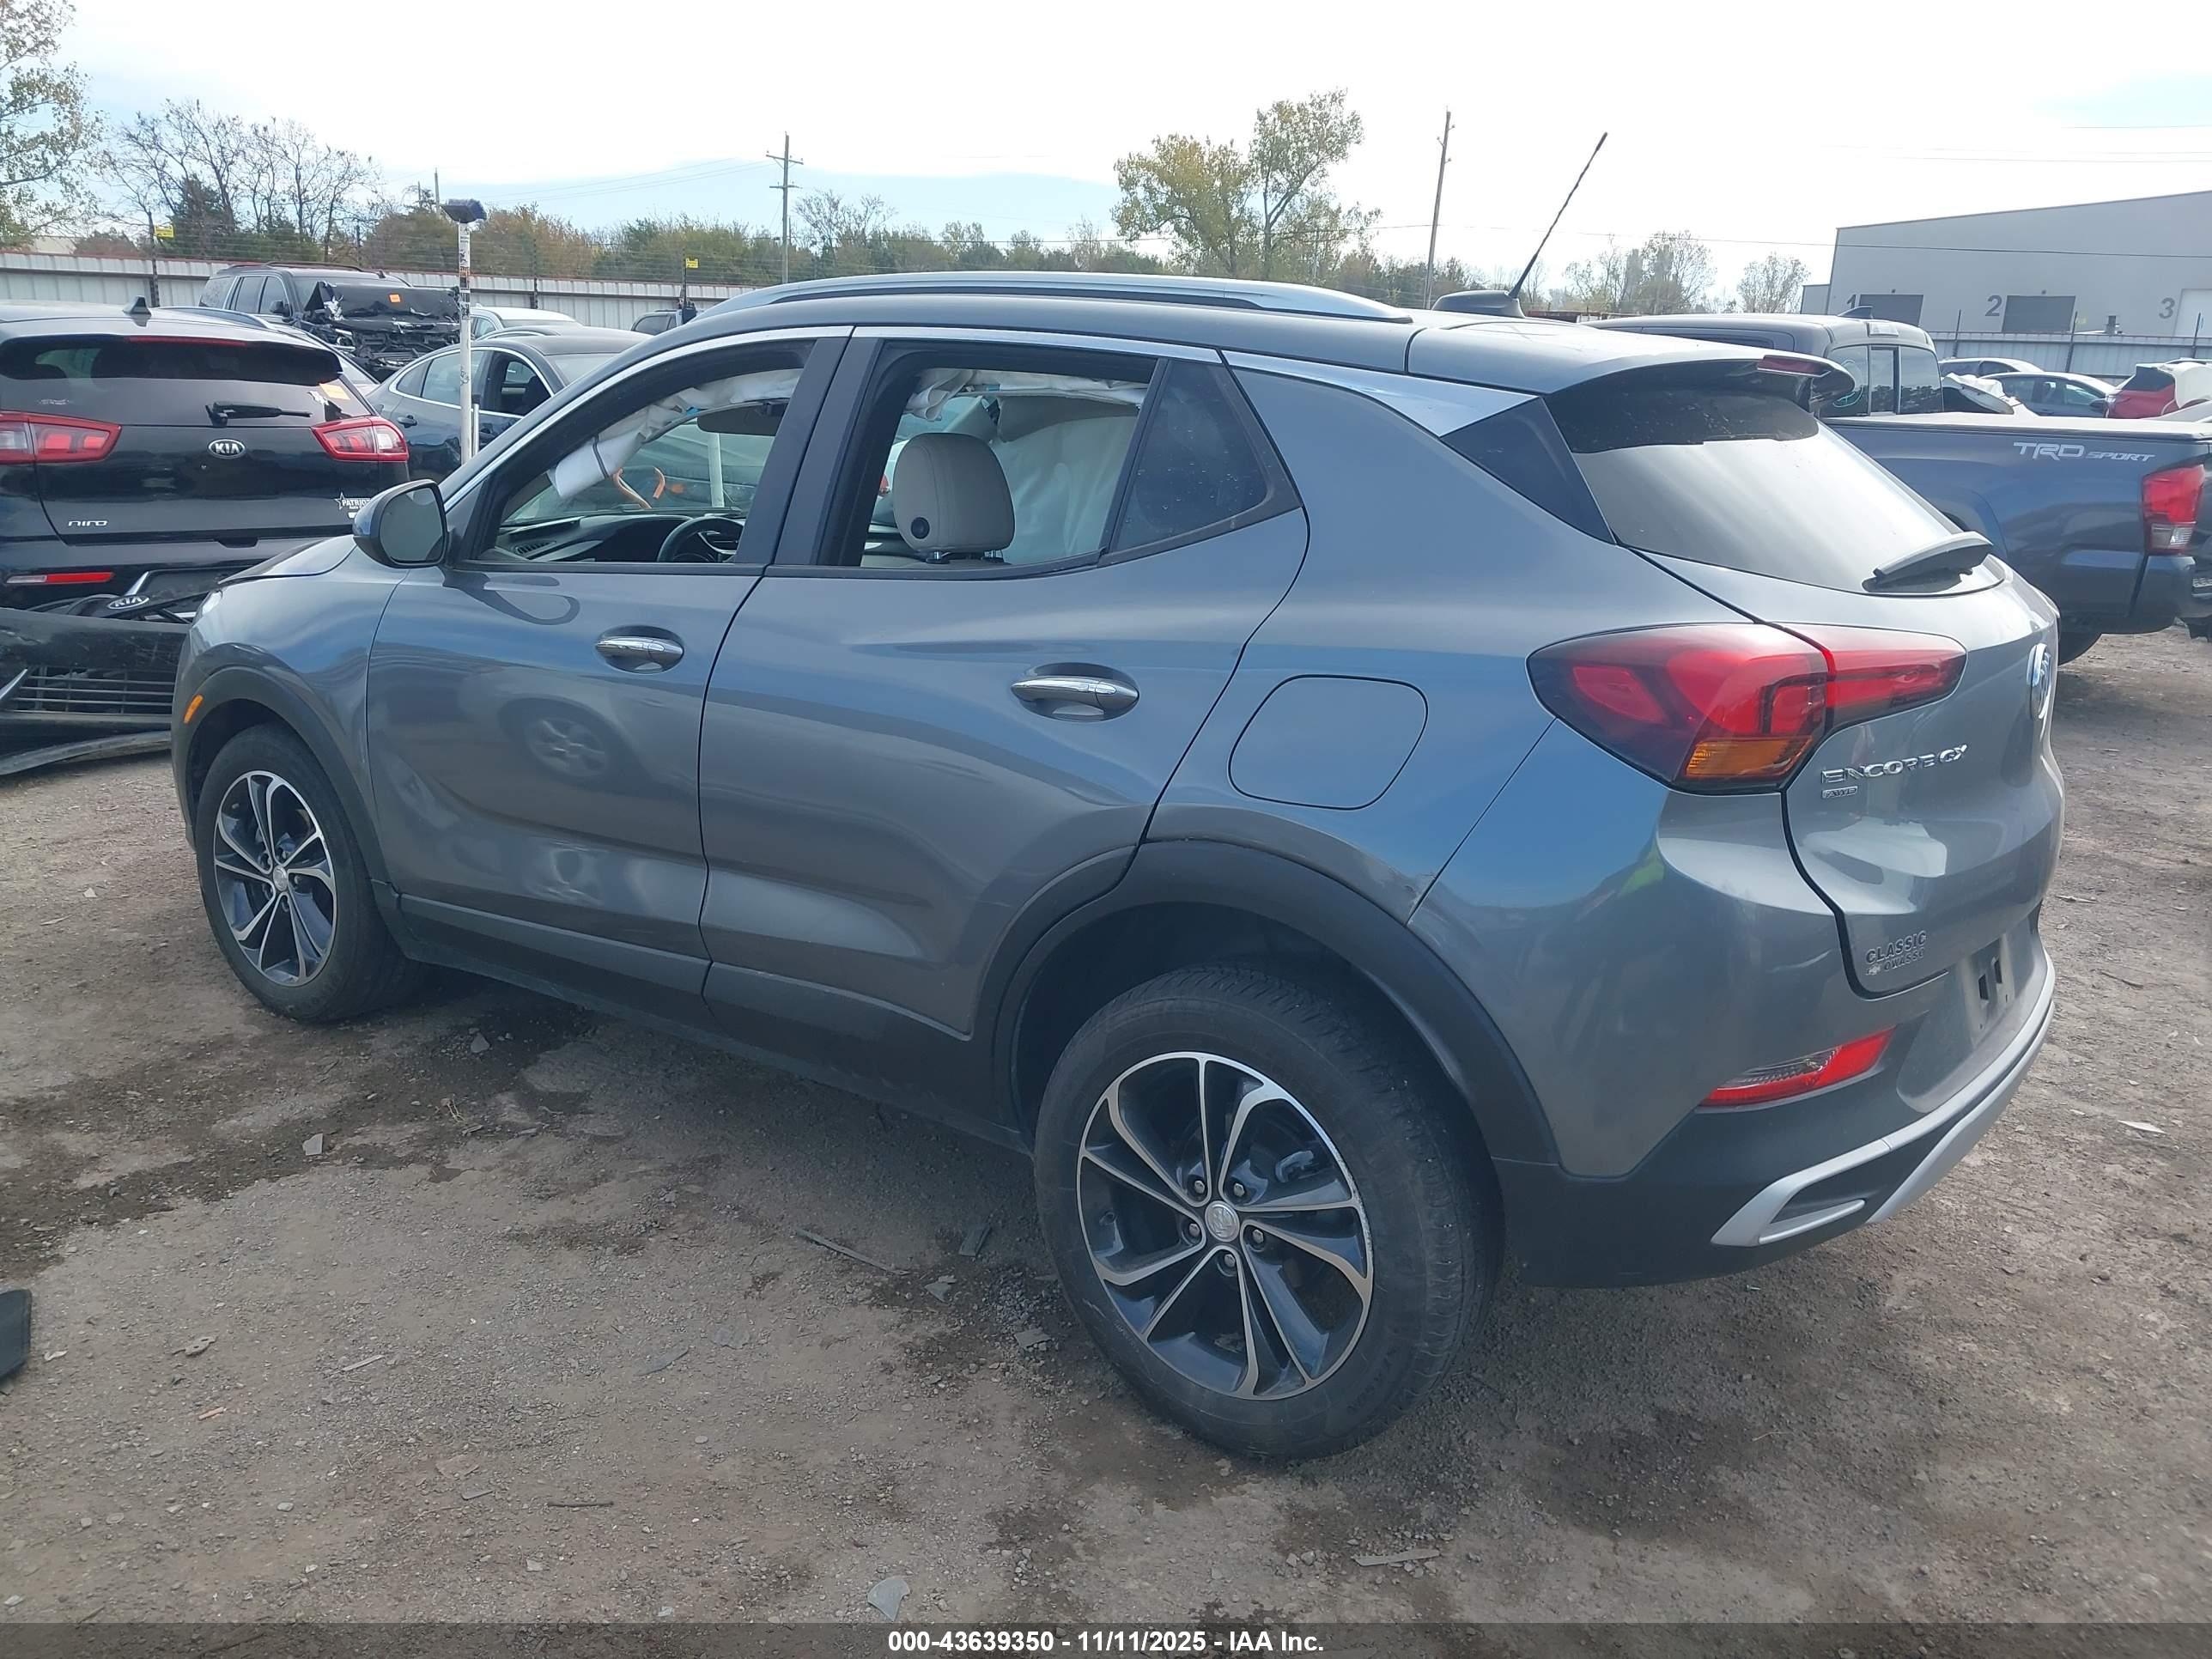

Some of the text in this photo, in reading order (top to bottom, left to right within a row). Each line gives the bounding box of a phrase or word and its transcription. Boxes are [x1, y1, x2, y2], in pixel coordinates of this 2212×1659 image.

[1846, 294, 1856, 310] 1
[1984, 295, 2002, 317] 2
[2159, 297, 2175, 319] 3
[215, 442, 240, 454] KIA
[2014, 441, 2156, 462] TRD SPORT
[1821, 744, 1967, 784] ENCORE GX
[1865, 930, 1927, 965] CLASSIC
[1884, 947, 1925, 972] OWASSO
